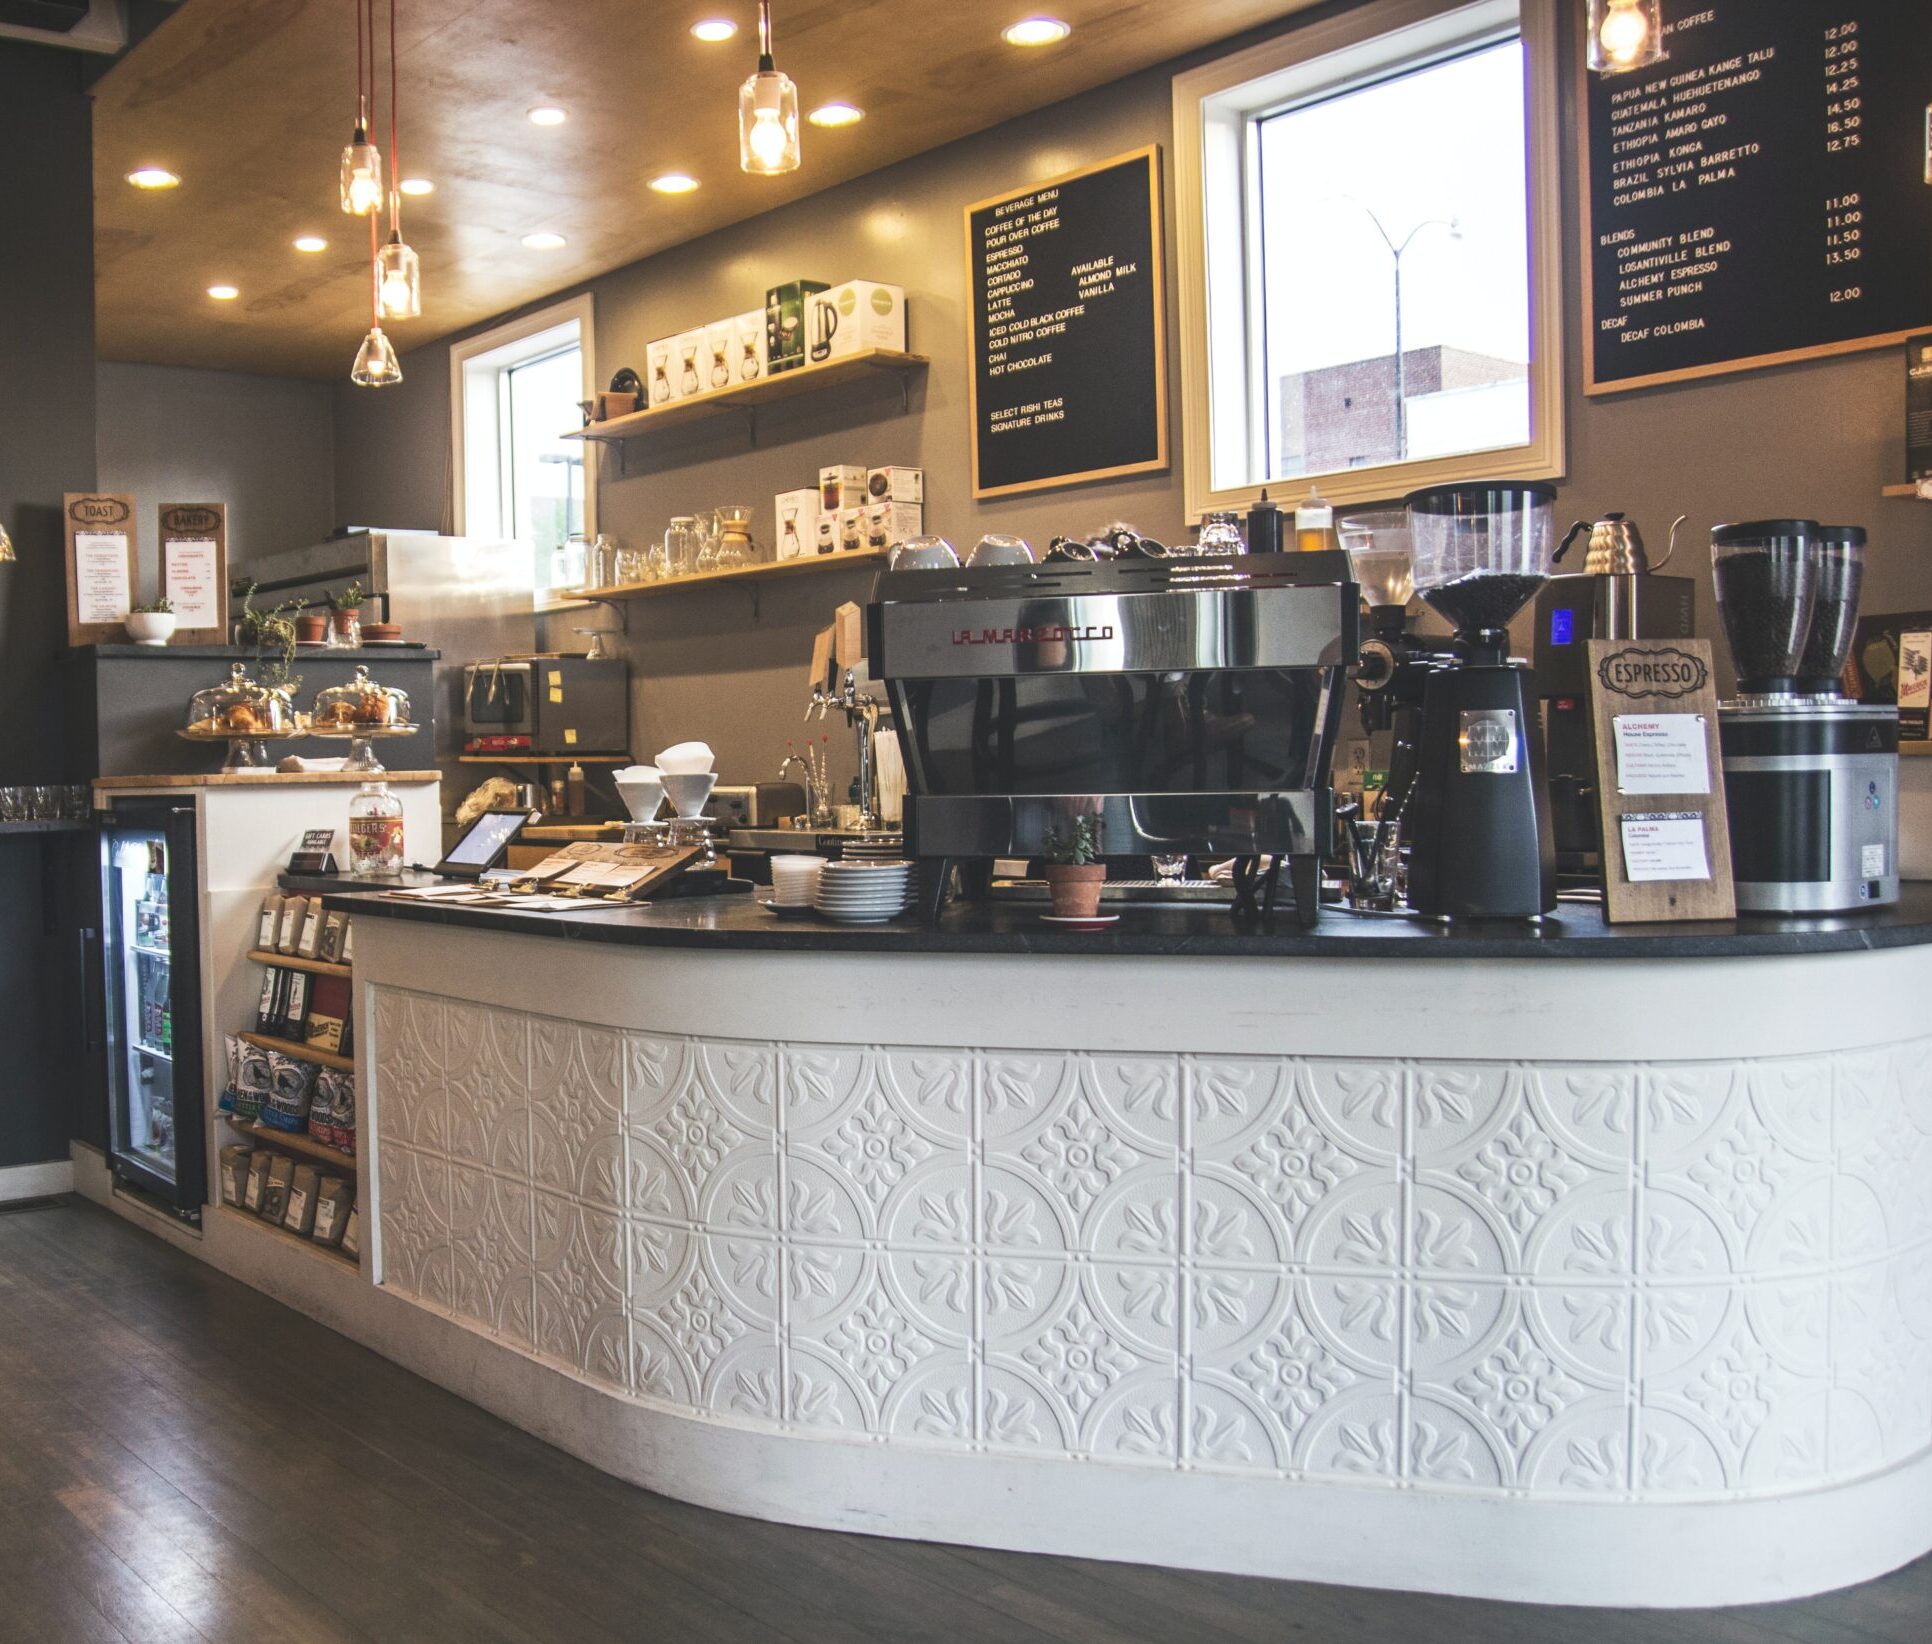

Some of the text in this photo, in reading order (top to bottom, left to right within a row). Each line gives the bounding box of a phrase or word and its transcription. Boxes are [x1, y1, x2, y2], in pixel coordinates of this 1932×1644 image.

[1677, 10, 1715, 31] COFFEE
[1825, 22, 1857, 40] 12.00
[1825, 40, 1857, 59] 12.00
[1612, 48, 1775, 104] PAPUA NEW GUINEA KANGE TALU
[1825, 58, 1857, 76] 12.25
[1827, 77, 1858, 94] 14.25
[1612, 98, 1667, 121] GUATEMALA
[1828, 98, 1860, 116] 14.50
[1612, 102, 1707, 137] TANZANIA KAMARO
[1828, 116, 1860, 133] 16.50
[1613, 114, 1727, 153] ETHIOPIA AMARO GAYO
[1827, 135, 1860, 152] 12.75
[1613, 152, 1660, 173] ETHIOPIA
[1614, 143, 1760, 190] BRAZIL SYLVIA BARRETTO
[1614, 167, 1736, 206] COLOMBIA LA PALMA
[996, 189, 1059, 216] BEVERAGE MENU
[1826, 194, 1858, 210] 11.00
[985, 206, 1058, 236] COFFEE OF THE DAY
[1828, 212, 1860, 228] 11.00
[986, 218, 1060, 248] POUR OVER COFFEE
[1600, 229, 1635, 245] BLENDS
[1618, 227, 1714, 258] COMMUNITY BLEND
[1827, 230, 1860, 246] 11.50
[986, 244, 1023, 262] ESPRESSO
[1620, 241, 1731, 274] LOSANTIVILLE BLEND
[1827, 248, 1860, 265] 13.50
[987, 255, 1028, 275] MACCHIATO
[1071, 256, 1114, 276] AVAILABLE
[1079, 262, 1136, 286] ALMOND MILK
[988, 270, 1021, 286] CORTADO
[1619, 261, 1718, 290] ALCHEMY ESPRESSO
[988, 279, 1034, 298] CAPPUCCINO
[1079, 282, 1115, 299] VANILLA
[1620, 282, 1702, 307] SUMMER PUNCH
[1830, 287, 1860, 303] 12.00
[988, 297, 1011, 311] LATTE
[989, 309, 1015, 323] MOCHA
[990, 305, 1085, 337] ICED COLD BLACK COFFEE
[1602, 316, 1628, 330] DECAF
[989, 322, 1066, 349] COLD NITRO COFFEE
[1621, 318, 1704, 342] DECAF COLOMBIA
[989, 352, 1007, 363] CHAI
[990, 353, 1052, 376] HOT CHOCOLATE
[991, 398, 1063, 420] SELECT RISHI TEAS
[991, 411, 1064, 432] SIGNATURE DRINKS
[84, 505, 114, 517] TOAST
[174, 514, 208, 525] BAKERY
[1615, 663, 1692, 683] ESPRESSO
